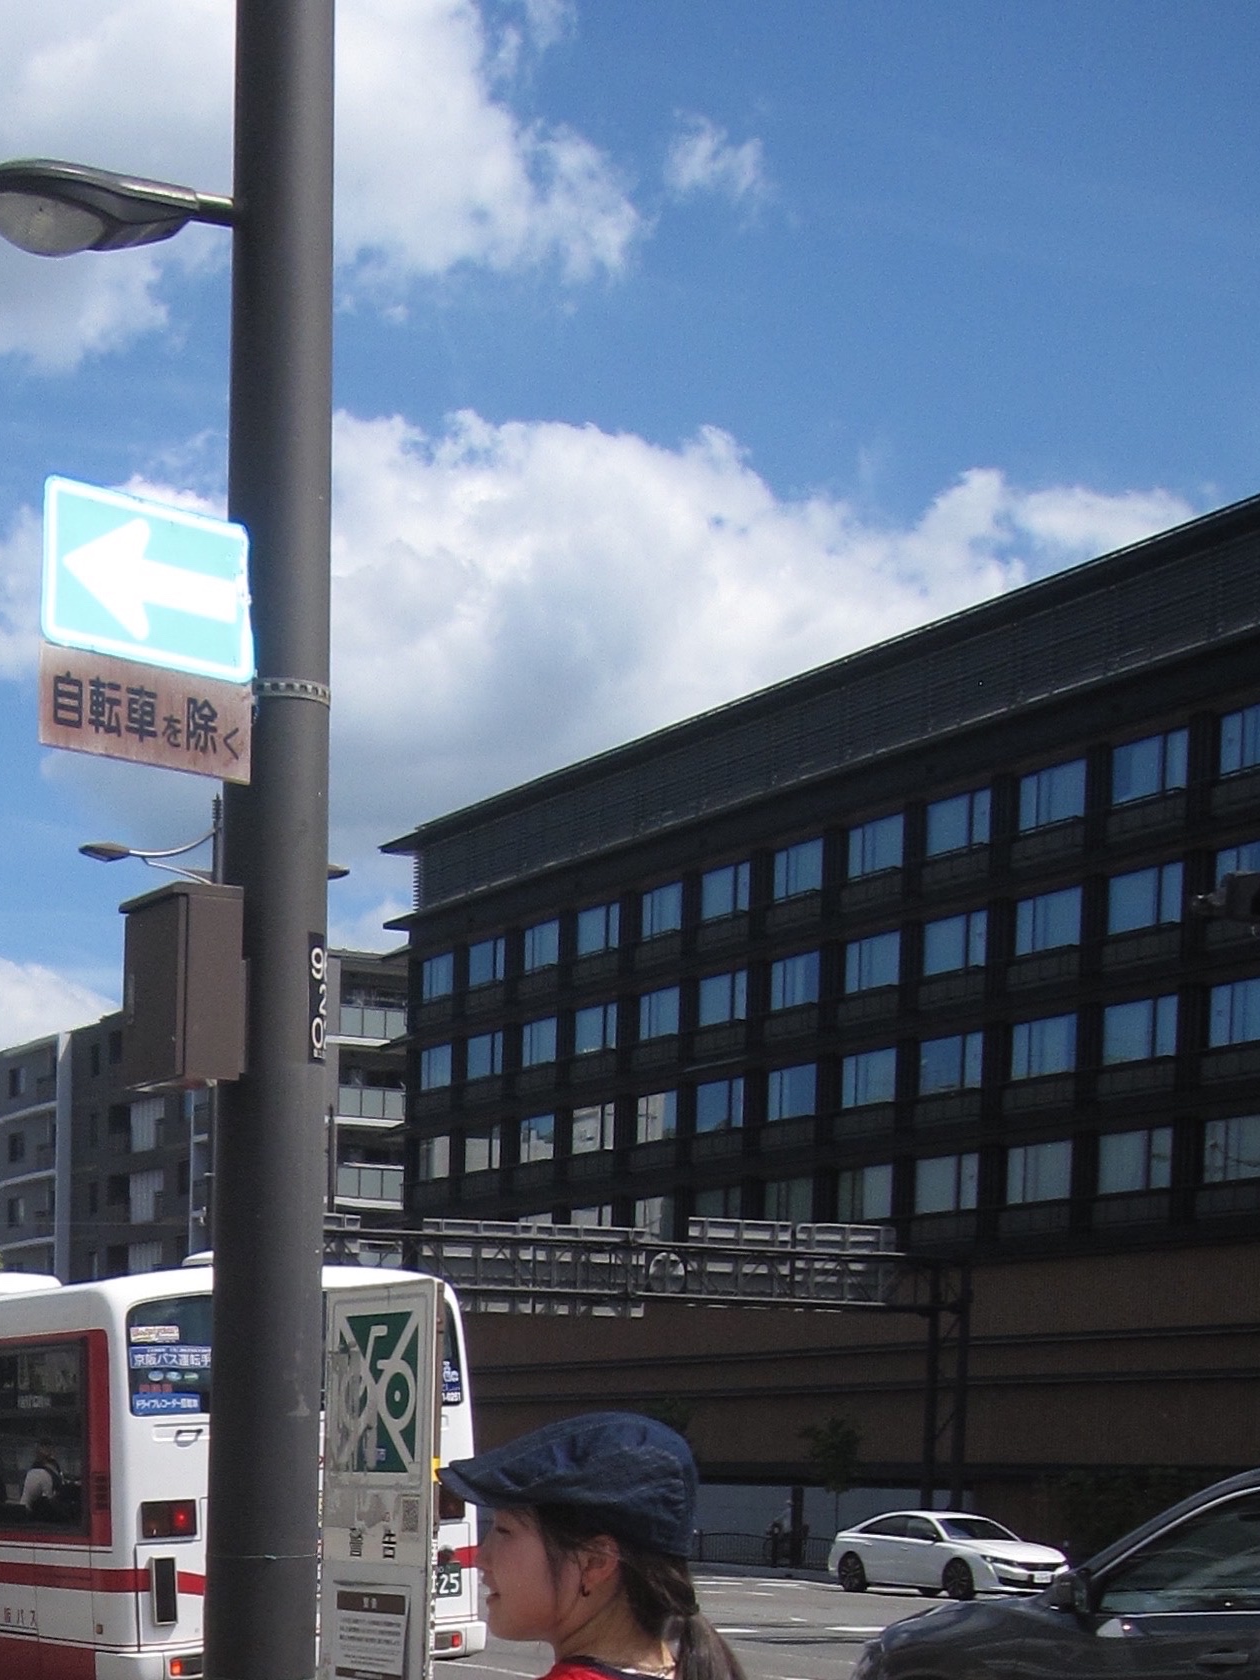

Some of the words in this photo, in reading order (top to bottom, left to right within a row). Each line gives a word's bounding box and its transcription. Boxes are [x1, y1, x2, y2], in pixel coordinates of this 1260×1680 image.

[53, 671, 240, 760] 自転車を除く
